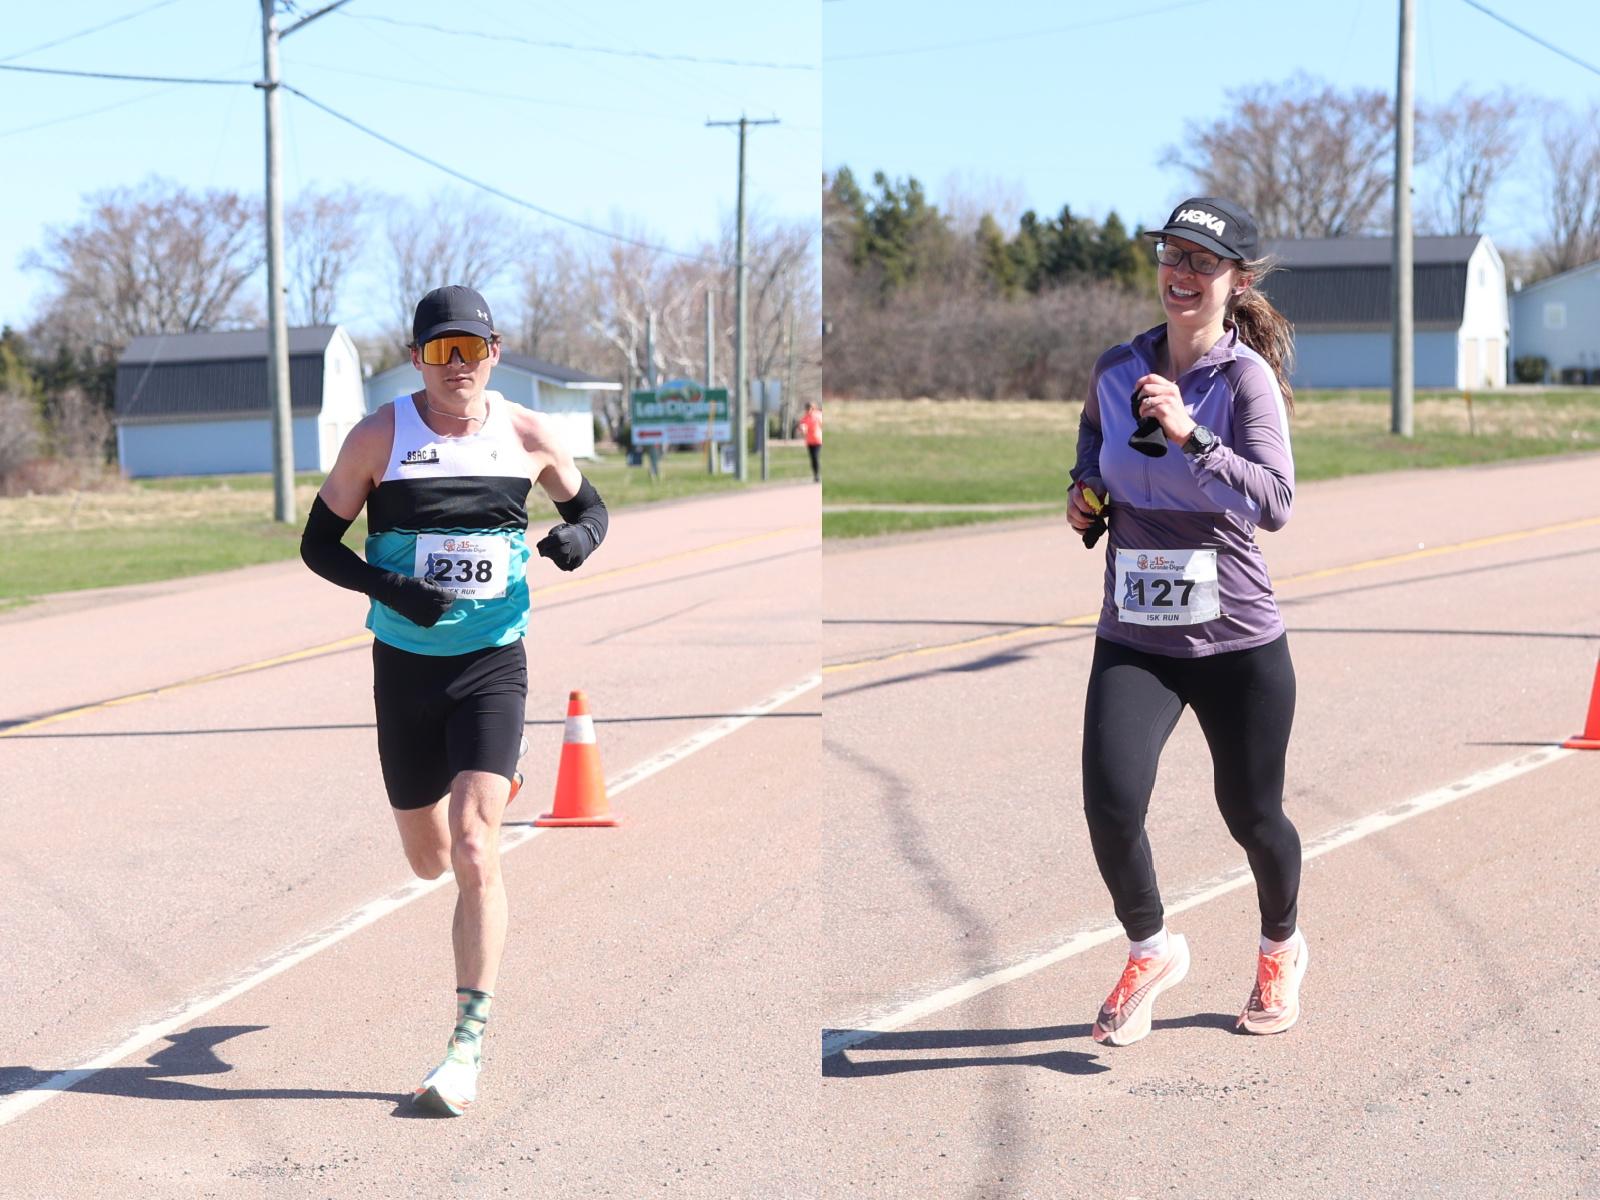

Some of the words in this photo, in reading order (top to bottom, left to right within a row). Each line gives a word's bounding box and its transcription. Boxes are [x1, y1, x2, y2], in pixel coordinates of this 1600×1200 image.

[1174, 208, 1226, 237] HOKA
[433, 559, 493, 583] 238
[1155, 556, 1164, 565] 15
[1132, 578, 1196, 607] 127
